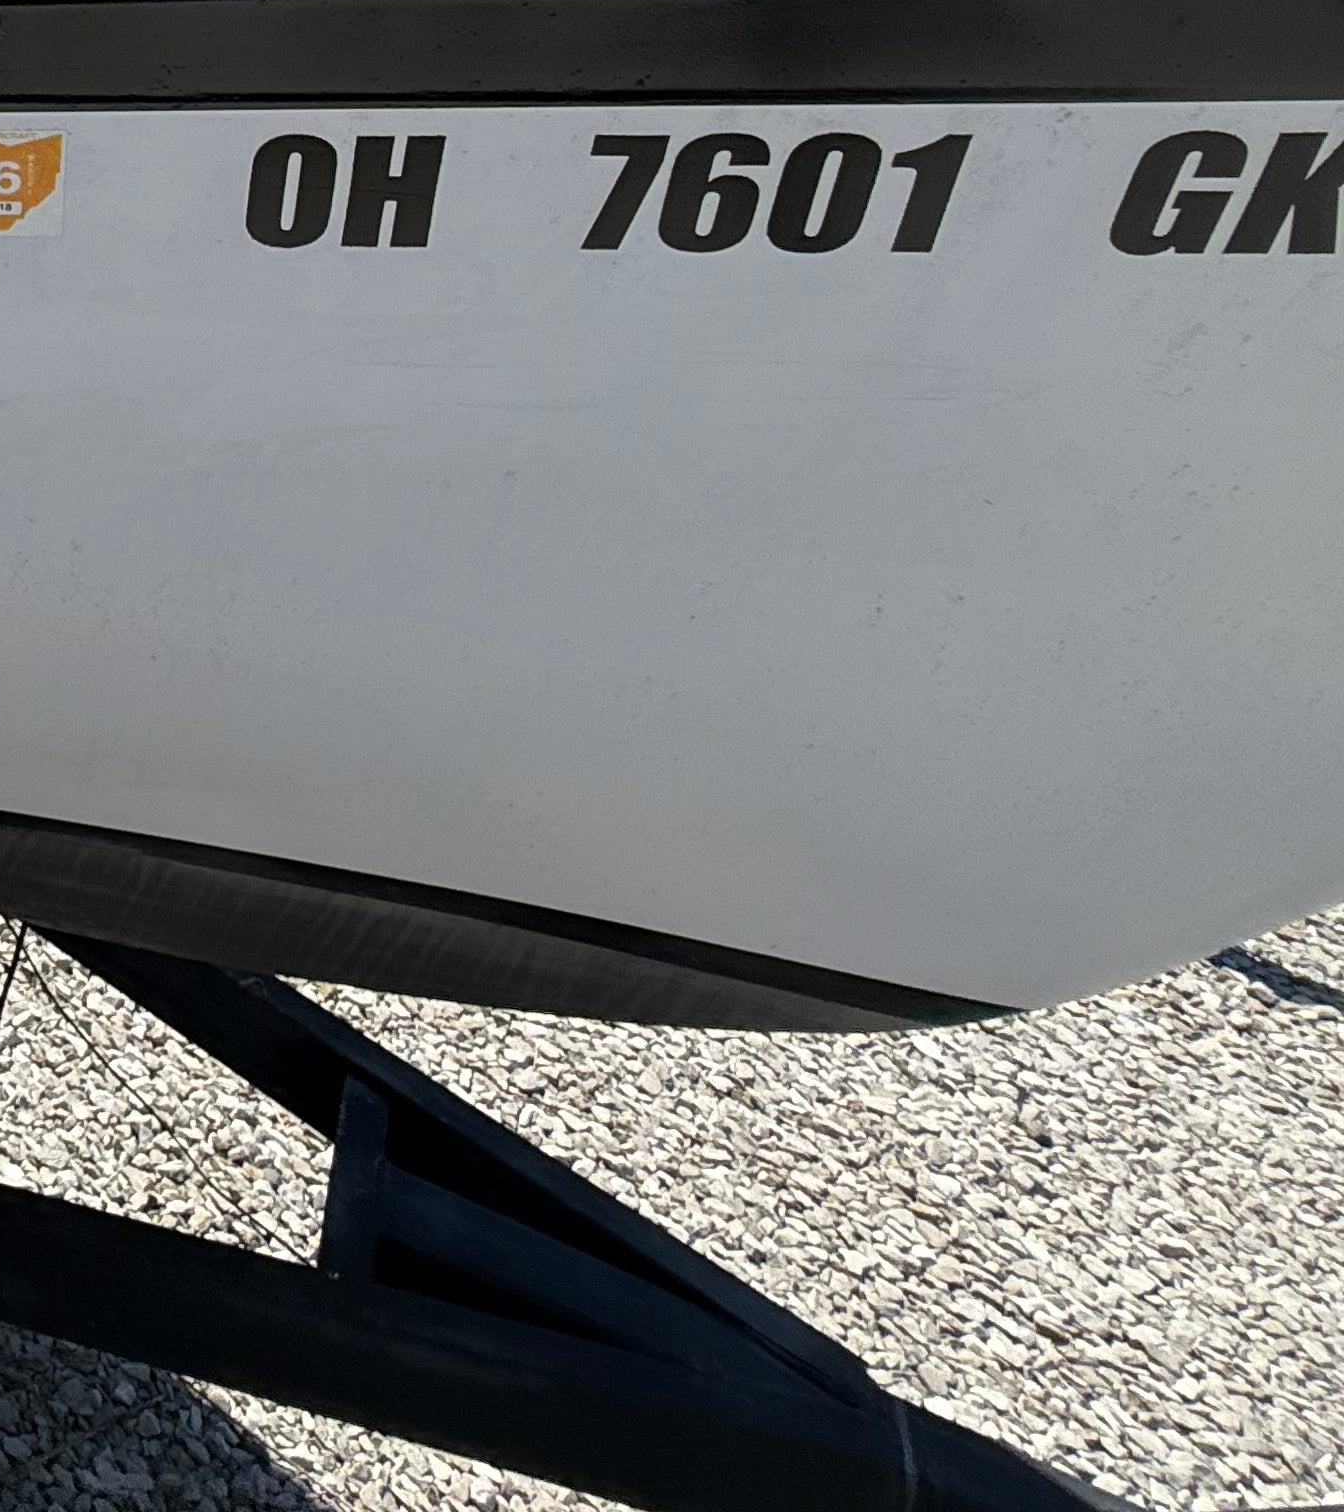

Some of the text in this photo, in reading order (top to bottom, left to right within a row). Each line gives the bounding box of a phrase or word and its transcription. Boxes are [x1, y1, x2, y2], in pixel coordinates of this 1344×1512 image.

[245, 130, 1344, 256] OH 7601 GK
